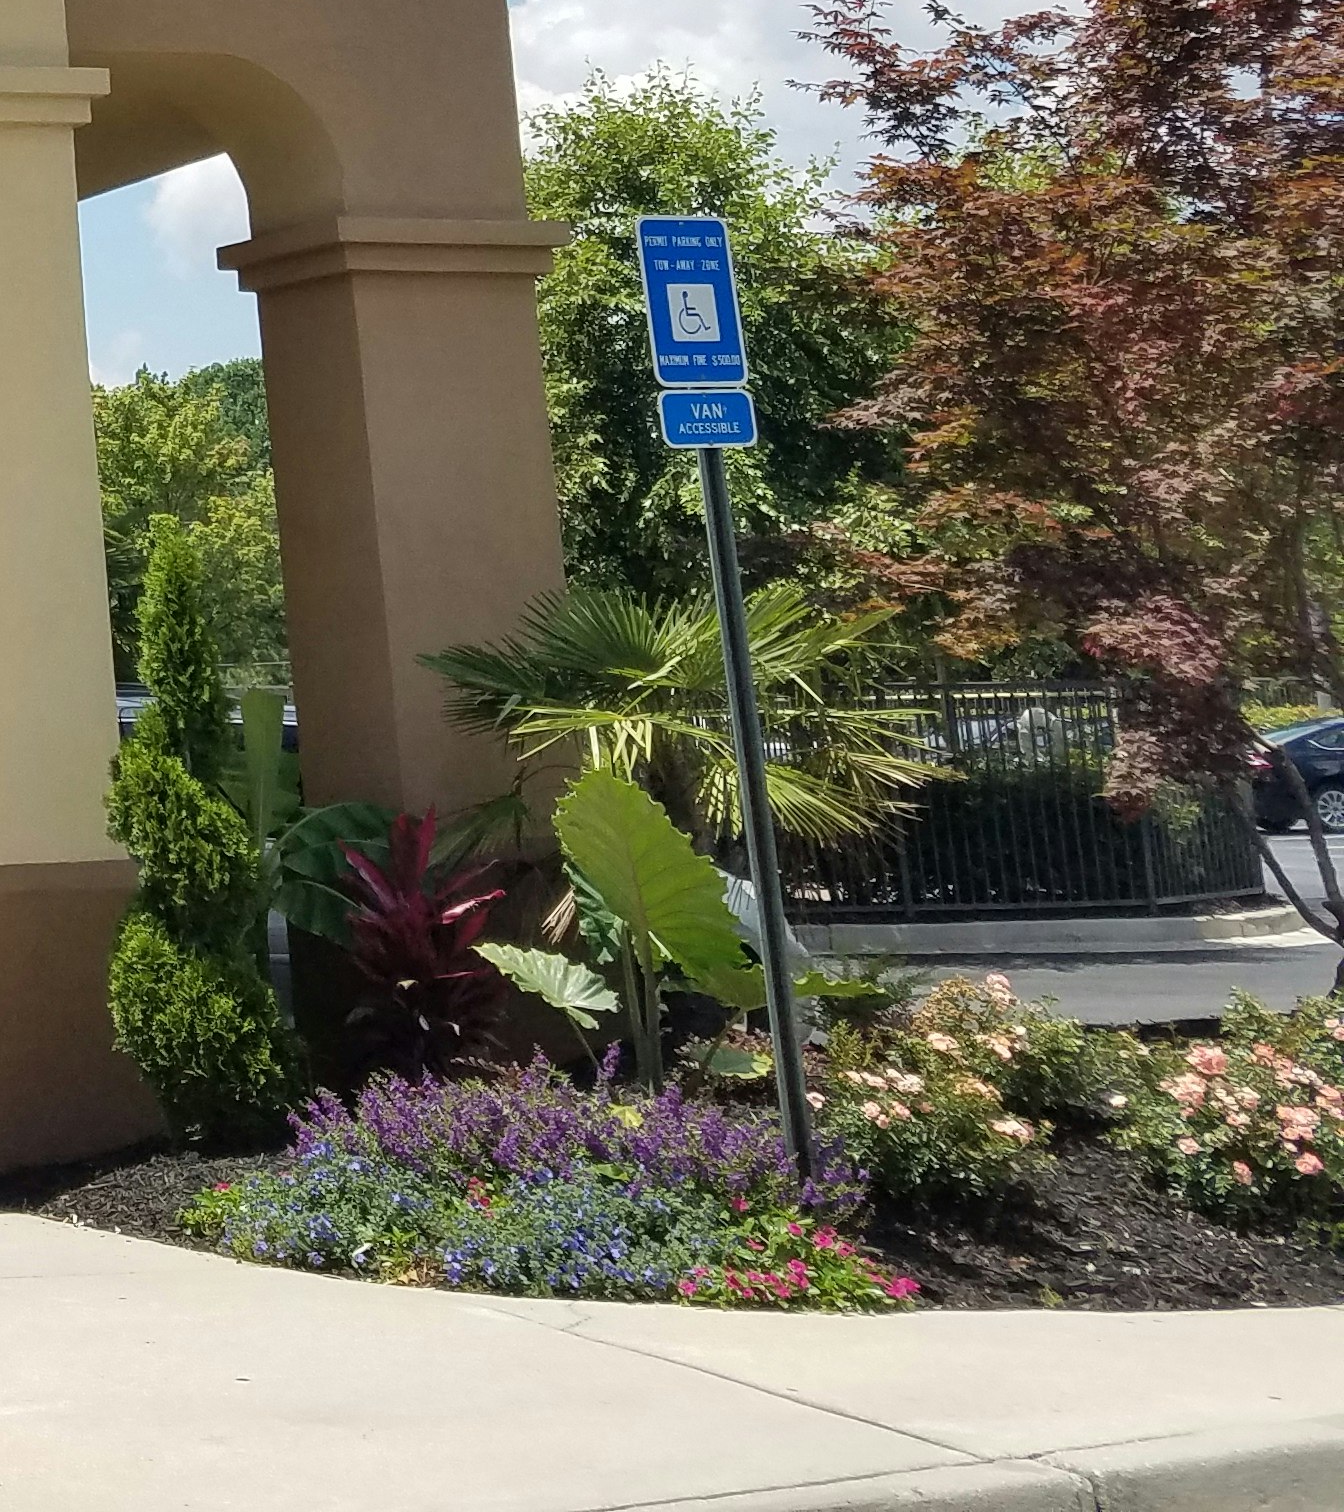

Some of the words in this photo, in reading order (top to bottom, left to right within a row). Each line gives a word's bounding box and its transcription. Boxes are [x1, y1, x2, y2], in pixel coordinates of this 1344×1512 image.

[643, 235, 668, 247] PERMIT
[672, 236, 702, 248] PARKING
[704, 236, 723, 248] ONLY
[700, 259, 721, 271] ZONE
[658, 354, 690, 367] MAXIMUM
[692, 354, 708, 366] FINE
[690, 402, 724, 420] VAN
[678, 421, 742, 435] ACCESSIBLE
